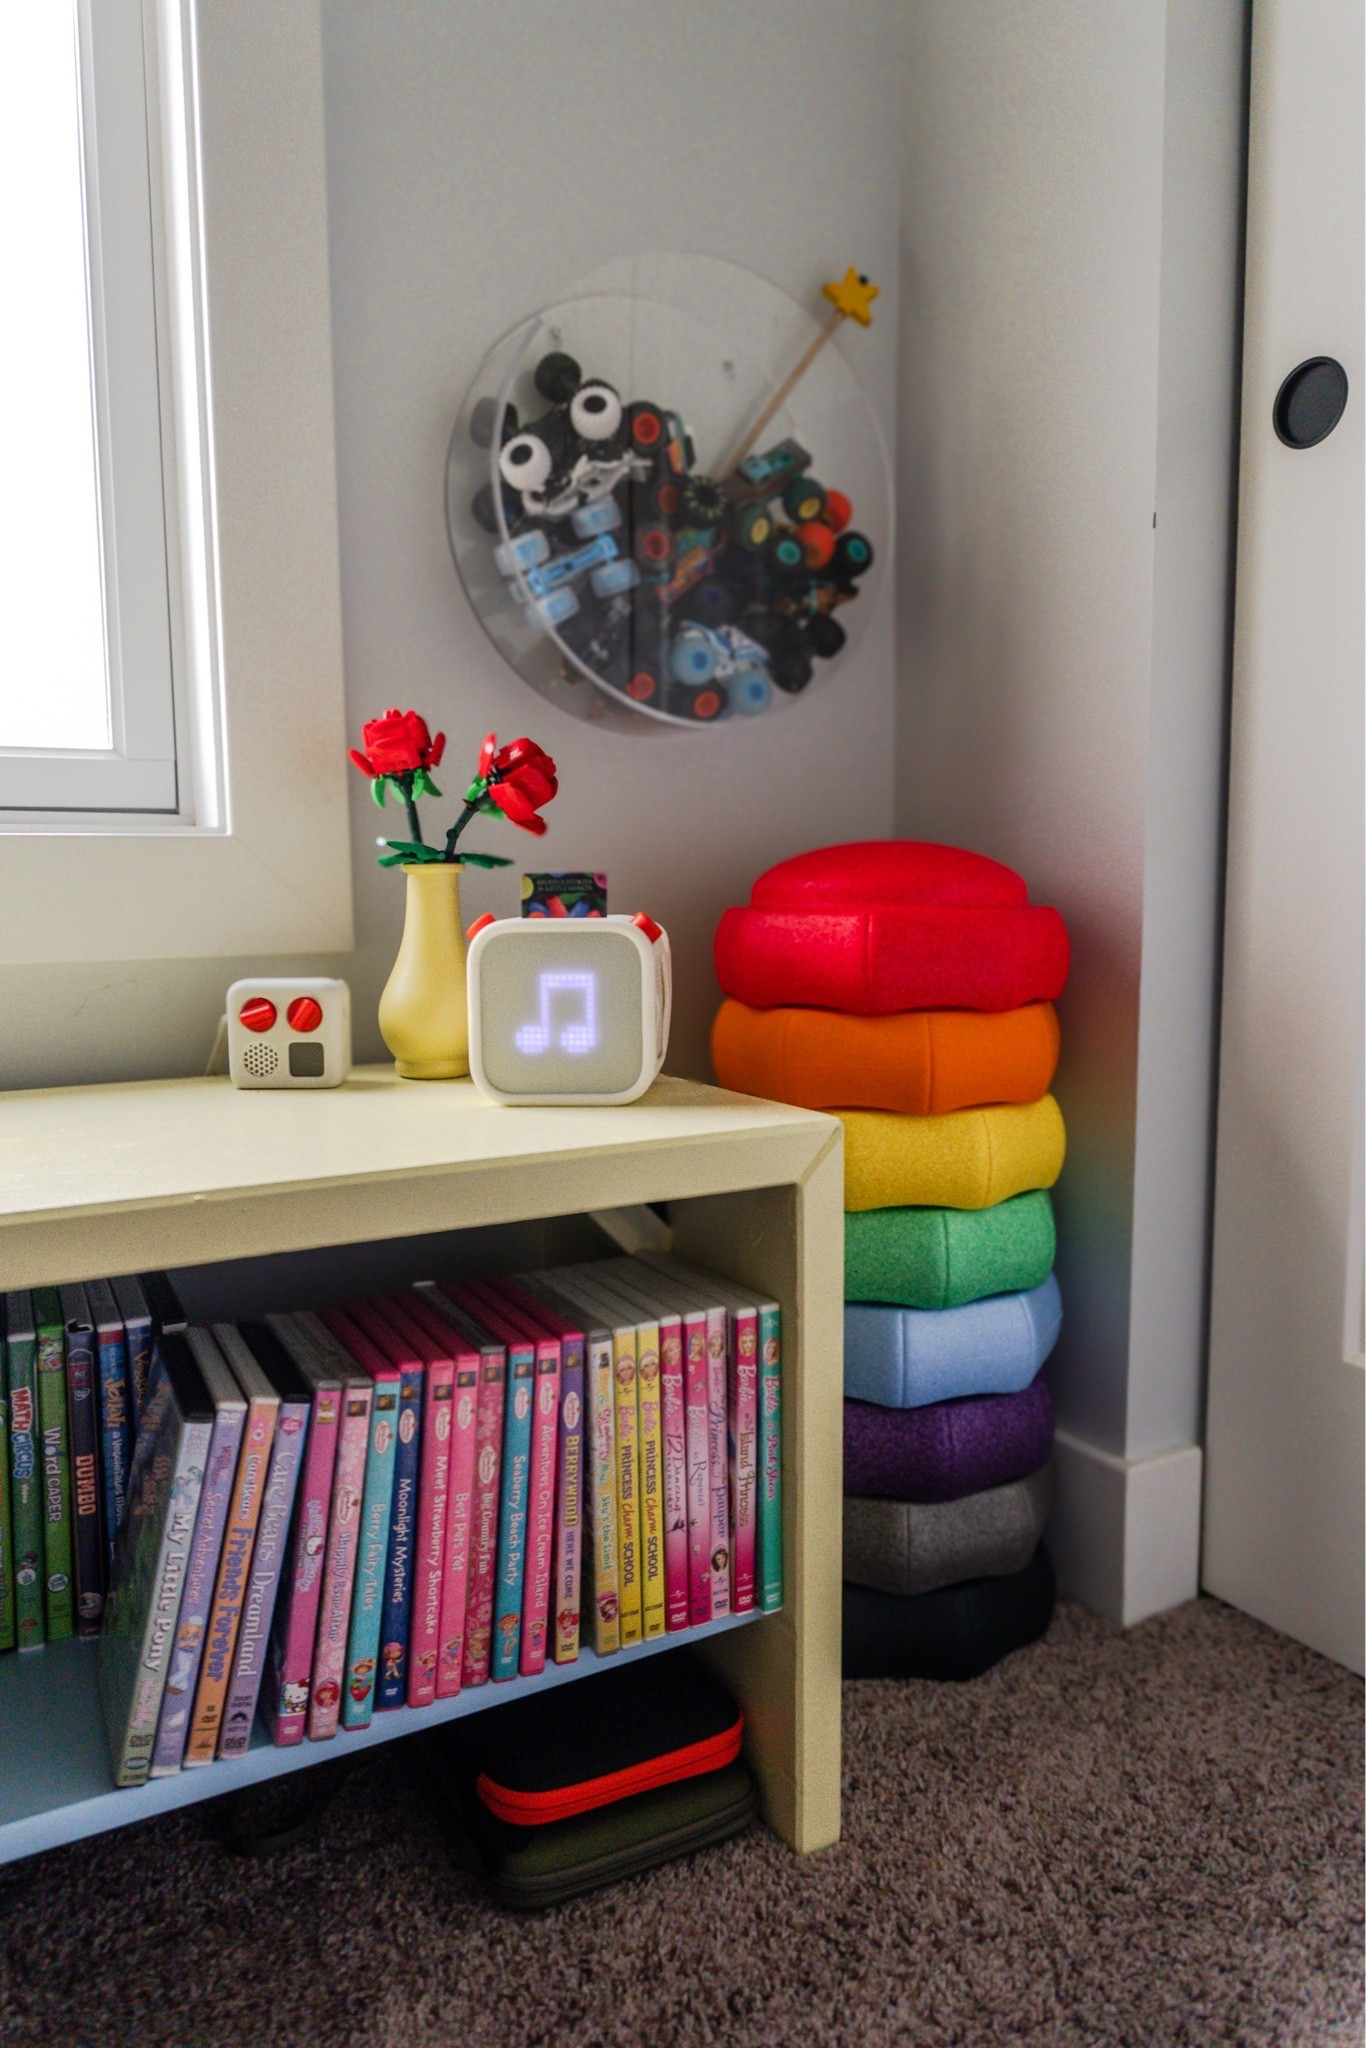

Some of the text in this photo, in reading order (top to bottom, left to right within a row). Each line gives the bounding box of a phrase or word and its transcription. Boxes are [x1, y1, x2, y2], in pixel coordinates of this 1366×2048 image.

[104, 1377, 126, 1428] Jonah
[662, 1374, 682, 1418] Barbie
[737, 1364, 757, 1404] Barbie
[762, 1376, 780, 1416] Barbie
[10, 1386, 33, 1433] MATH
[12, 1432, 34, 1479] CIRCUS
[539, 1426, 554, 1487] Adventures
[666, 1434, 684, 1456] 12
[709, 1402, 726, 1466] Princess
[739, 1430, 754, 1470] Island
[76, 1454, 96, 1515] DUMBO
[268, 1452, 297, 1500] Care
[434, 1456, 448, 1489] Meet
[564, 1435, 580, 1527] BERRYWOOD
[622, 1445, 635, 1500] PRINCESS
[646, 1440, 658, 1494] PRINCESS
[689, 1460, 707, 1506] Rapunzel
[47, 1478, 62, 1522] CAPER
[201, 1492, 224, 1530] Secret
[481, 1492, 494, 1509] Big
[505, 1456, 525, 1585] Seaberry Beach Party
[538, 1512, 550, 1530] Ice
[539, 1491, 550, 1509] On
[622, 1503, 634, 1540] Charm
[645, 1498, 658, 1535] Charm
[712, 1484, 727, 1538] Pauper
[737, 1471, 755, 1527] Princess
[167, 1512, 192, 1545] My
[259, 1503, 288, 1561] Bears
[392, 1478, 412, 1603] Moonlight Mysteries
[427, 1494, 446, 1566] Strawberry
[452, 1492, 470, 1570] Best Pets Yet
[479, 1511, 493, 1552] Country
[537, 1534, 550, 1569] Cream
[566, 1531, 574, 1553] HERE
[602, 1524, 612, 1543] the
[187, 1534, 214, 1605] Adventures
[218, 1528, 254, 1600] Friends
[363, 1503, 388, 1610] Berry Fairy Tales
[479, 1554, 490, 1574] Fun
[566, 1558, 574, 1572] WE
[603, 1544, 613, 1571] Limit
[624, 1542, 633, 1588] SCHOOL
[648, 1536, 658, 1581] SCHOOL
[158, 1551, 186, 1612] Little
[426, 1570, 442, 1634] Shortcake
[535, 1573, 548, 1607] Island
[564, 1575, 573, 1600] COME
[143, 1618, 174, 1672] Pony
[207, 1605, 240, 1682] Forever
[236, 1571, 276, 1676] Dreamland
